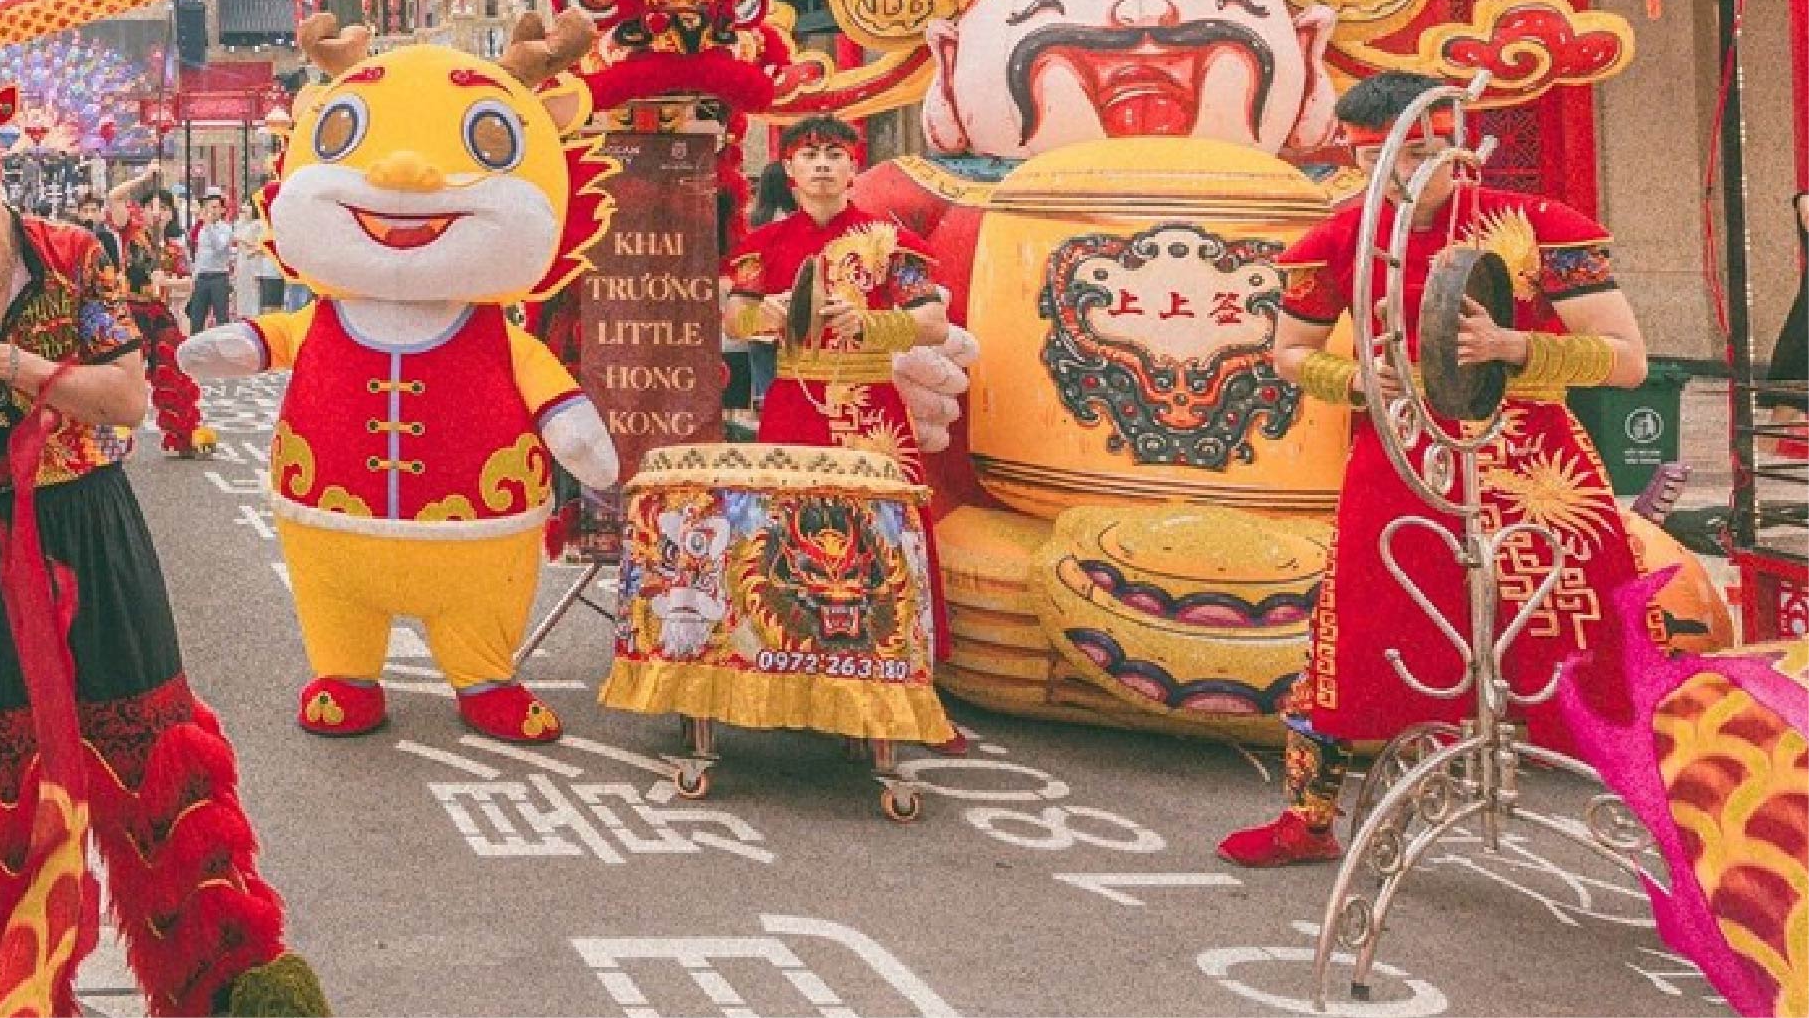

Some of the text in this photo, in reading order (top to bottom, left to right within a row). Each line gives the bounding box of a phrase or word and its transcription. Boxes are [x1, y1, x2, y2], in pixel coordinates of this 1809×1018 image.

[613, 232, 684, 257] KHAI
[587, 272, 713, 302] TRƯƠNG
[1107, 288, 1247, 326] 上上签
[597, 321, 703, 347] LITTLE
[606, 365, 697, 393] HONG
[607, 411, 697, 438] KONG
